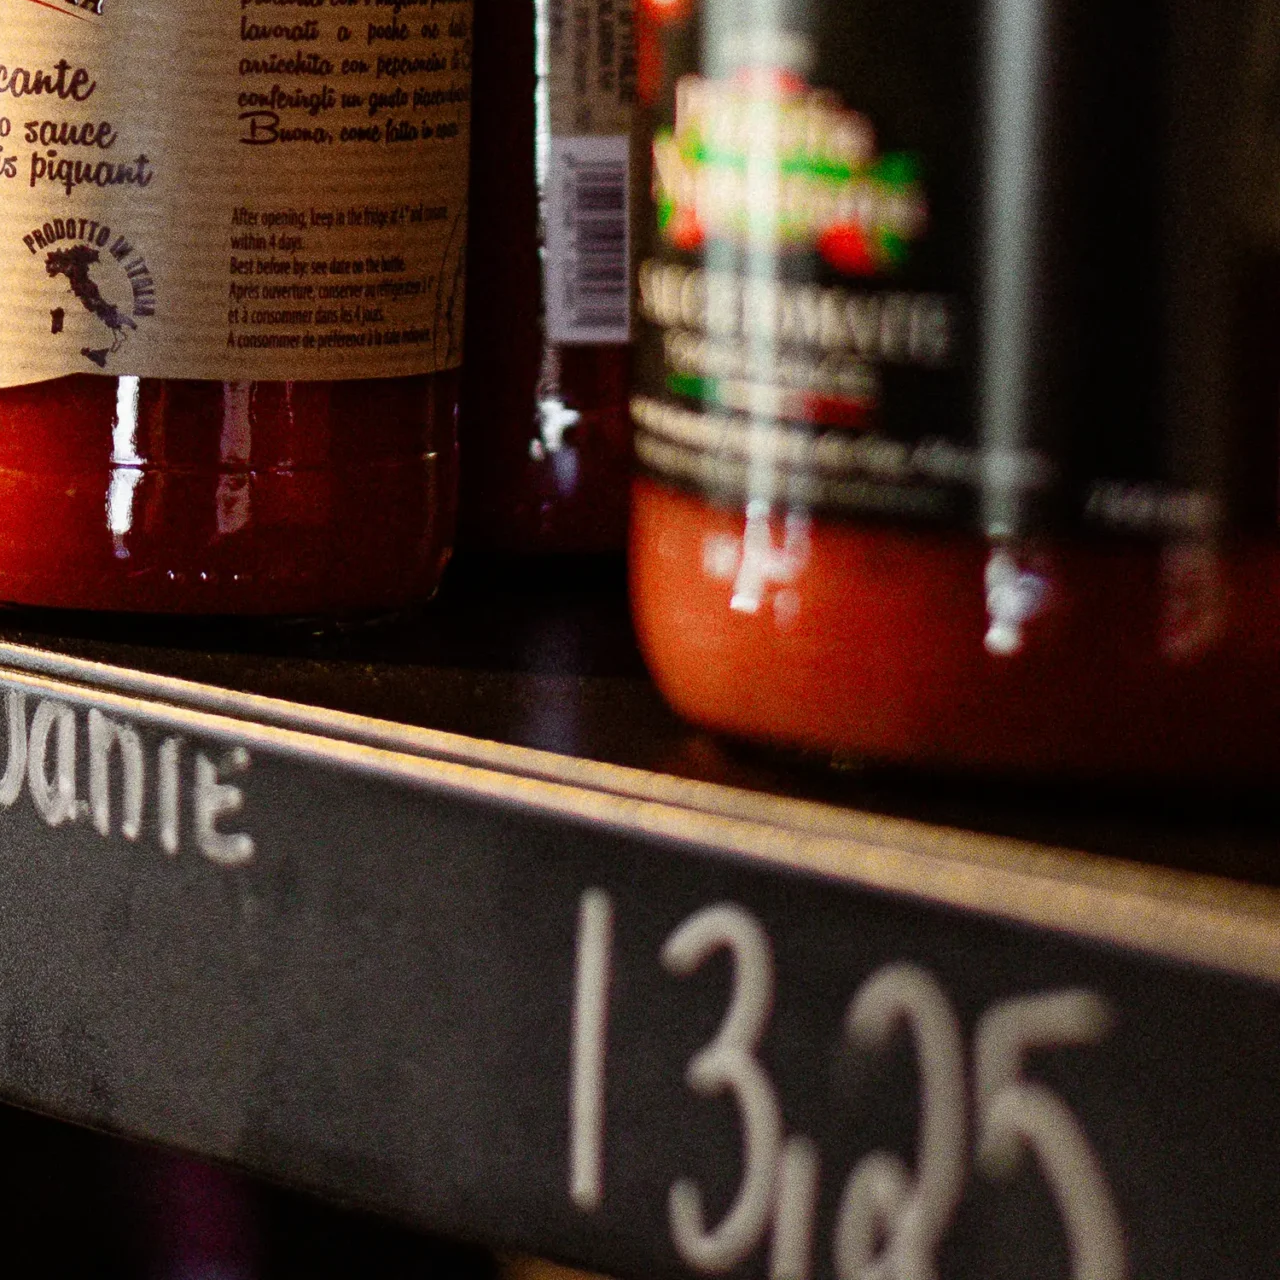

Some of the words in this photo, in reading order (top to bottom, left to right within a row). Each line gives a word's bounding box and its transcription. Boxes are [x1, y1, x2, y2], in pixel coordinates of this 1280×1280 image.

[240, 16, 320, 42] lavorati
[337, 24, 352, 42] a
[341, 59, 371, 75] con
[341, 92, 363, 108] un
[24, 118, 118, 150] sauce
[339, 123, 382, 143] come
[29, 148, 155, 195] piquant
[231, 206, 258, 226] After
[310, 206, 332, 229] keep
[230, 234, 267, 251] within
[269, 234, 277, 251] 4
[22, 217, 111, 255] PRODOTTO
[109, 234, 134, 262] IN
[124, 256, 157, 317] ITALIA
[230, 256, 255, 275] Best
[257, 256, 291, 276] before
[311, 261, 329, 276] see
[329, 257, 351, 276] date
[228, 280, 259, 303] Après
[227, 307, 240, 325] et
[251, 308, 313, 325] consommer
[237, 332, 301, 349] consommer
[303, 330, 316, 348] de
